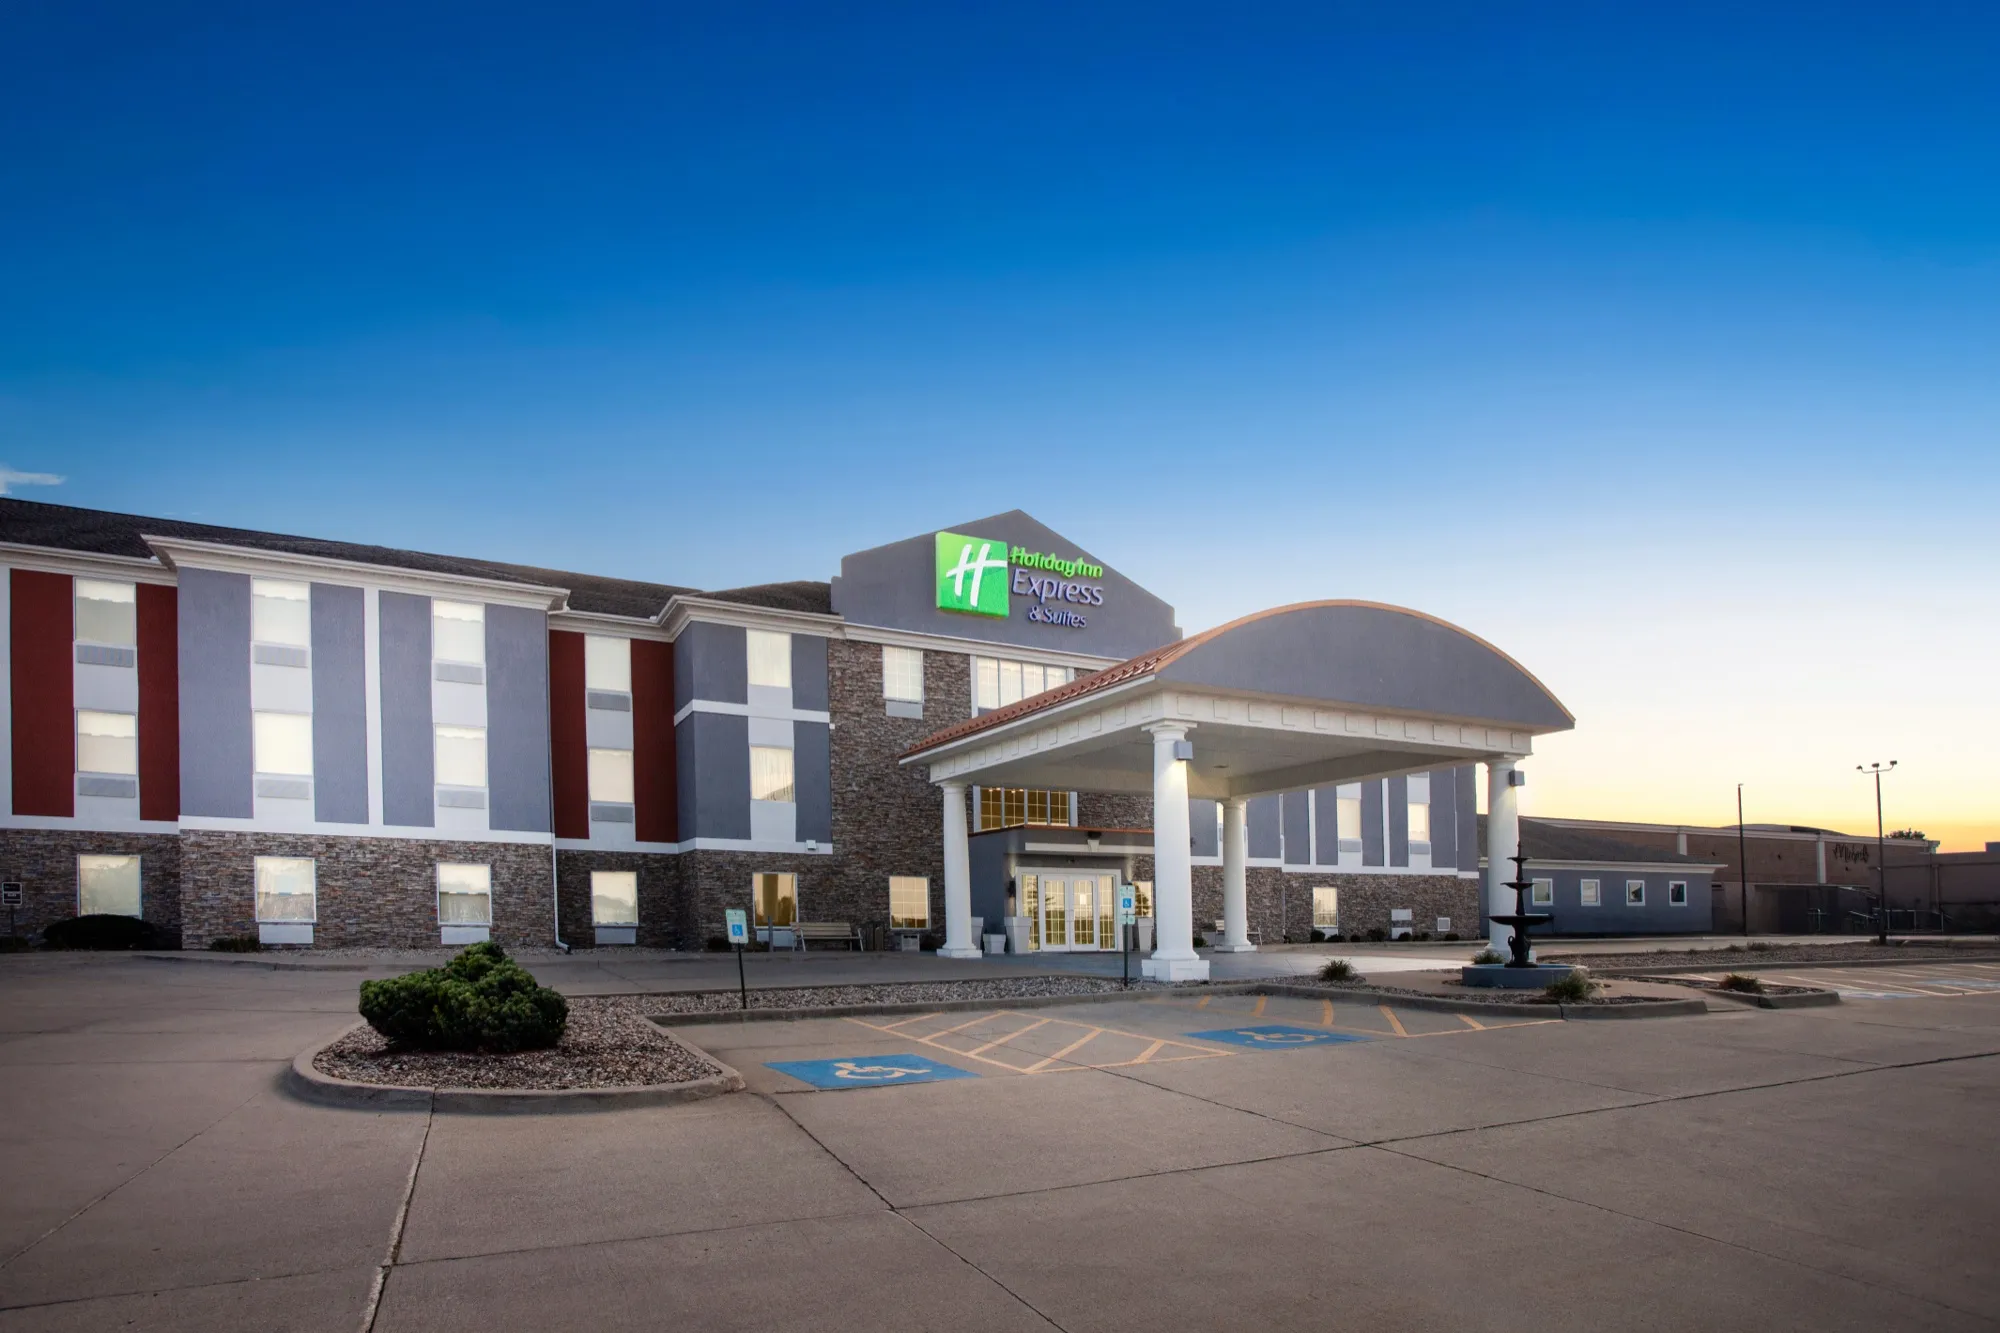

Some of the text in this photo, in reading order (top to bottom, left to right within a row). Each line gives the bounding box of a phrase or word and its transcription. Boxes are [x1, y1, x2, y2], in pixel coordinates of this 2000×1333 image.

[1009, 545, 1104, 579] Holiday Inn
[1011, 567, 1104, 606] Express
